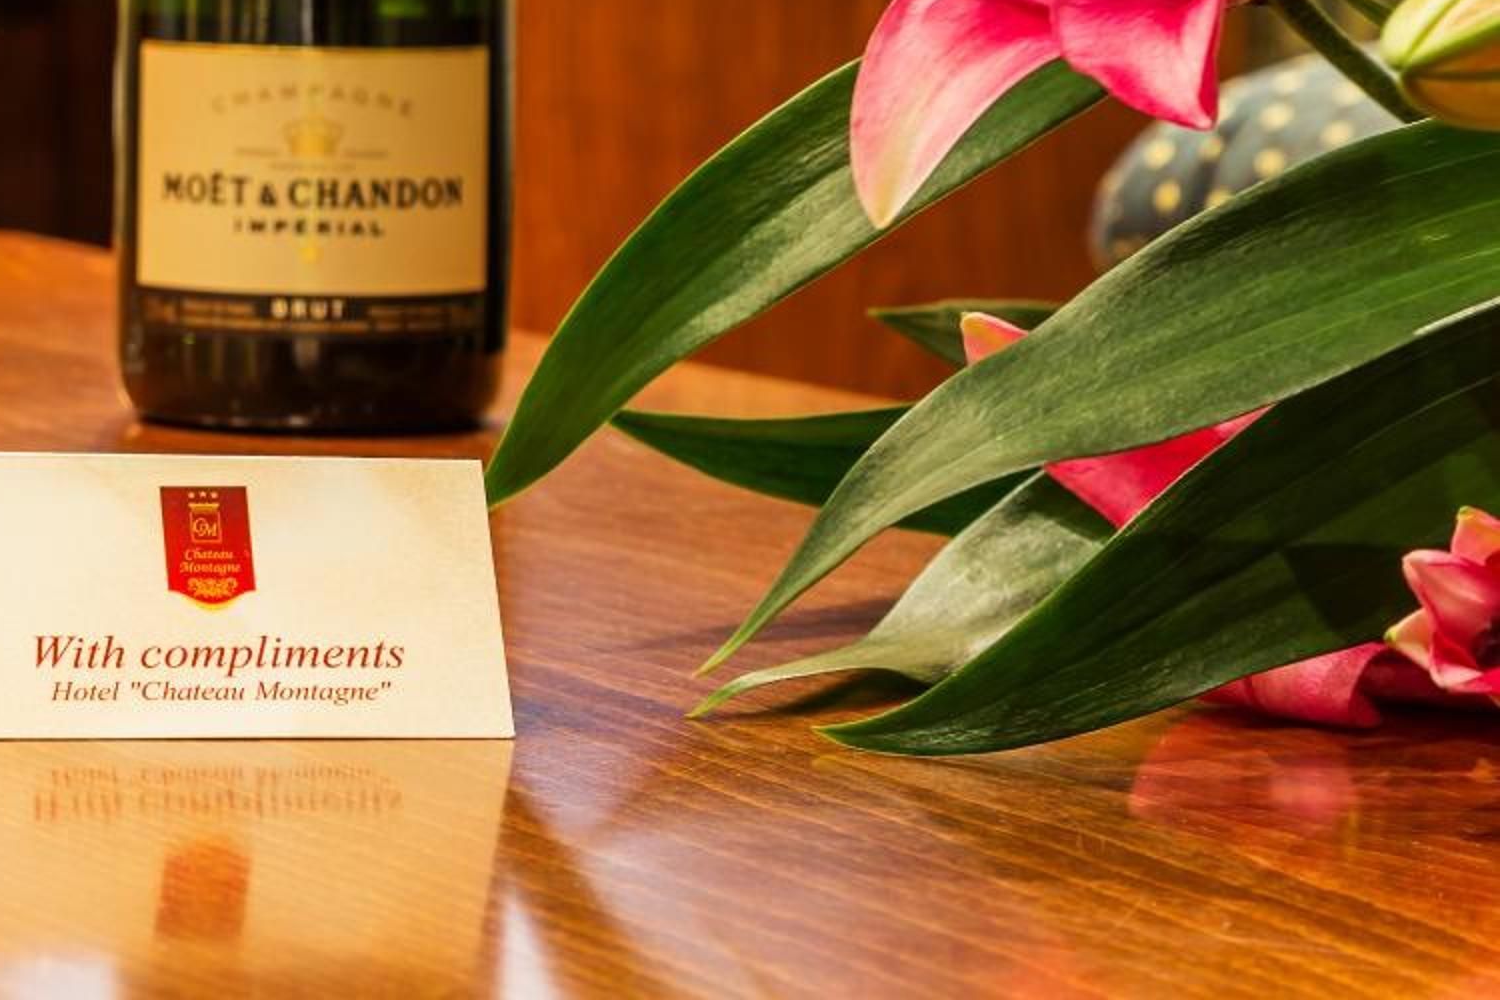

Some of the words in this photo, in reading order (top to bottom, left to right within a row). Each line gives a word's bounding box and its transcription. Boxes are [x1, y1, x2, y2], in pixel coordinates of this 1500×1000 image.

[211, 83, 414, 118] CHAMPAGNE
[258, 182, 278, 208] &
[286, 176, 465, 210] CHANDON
[269, 297, 346, 320] BRUT
[184, 547, 234, 561] Chateau
[179, 561, 241, 576] Montagne
[34, 634, 126, 669] With
[140, 634, 405, 678] compliments
[51, 680, 120, 701] Hotel
[131, 680, 245, 702] "Chateau
[254, 680, 392, 705] Montagne"
